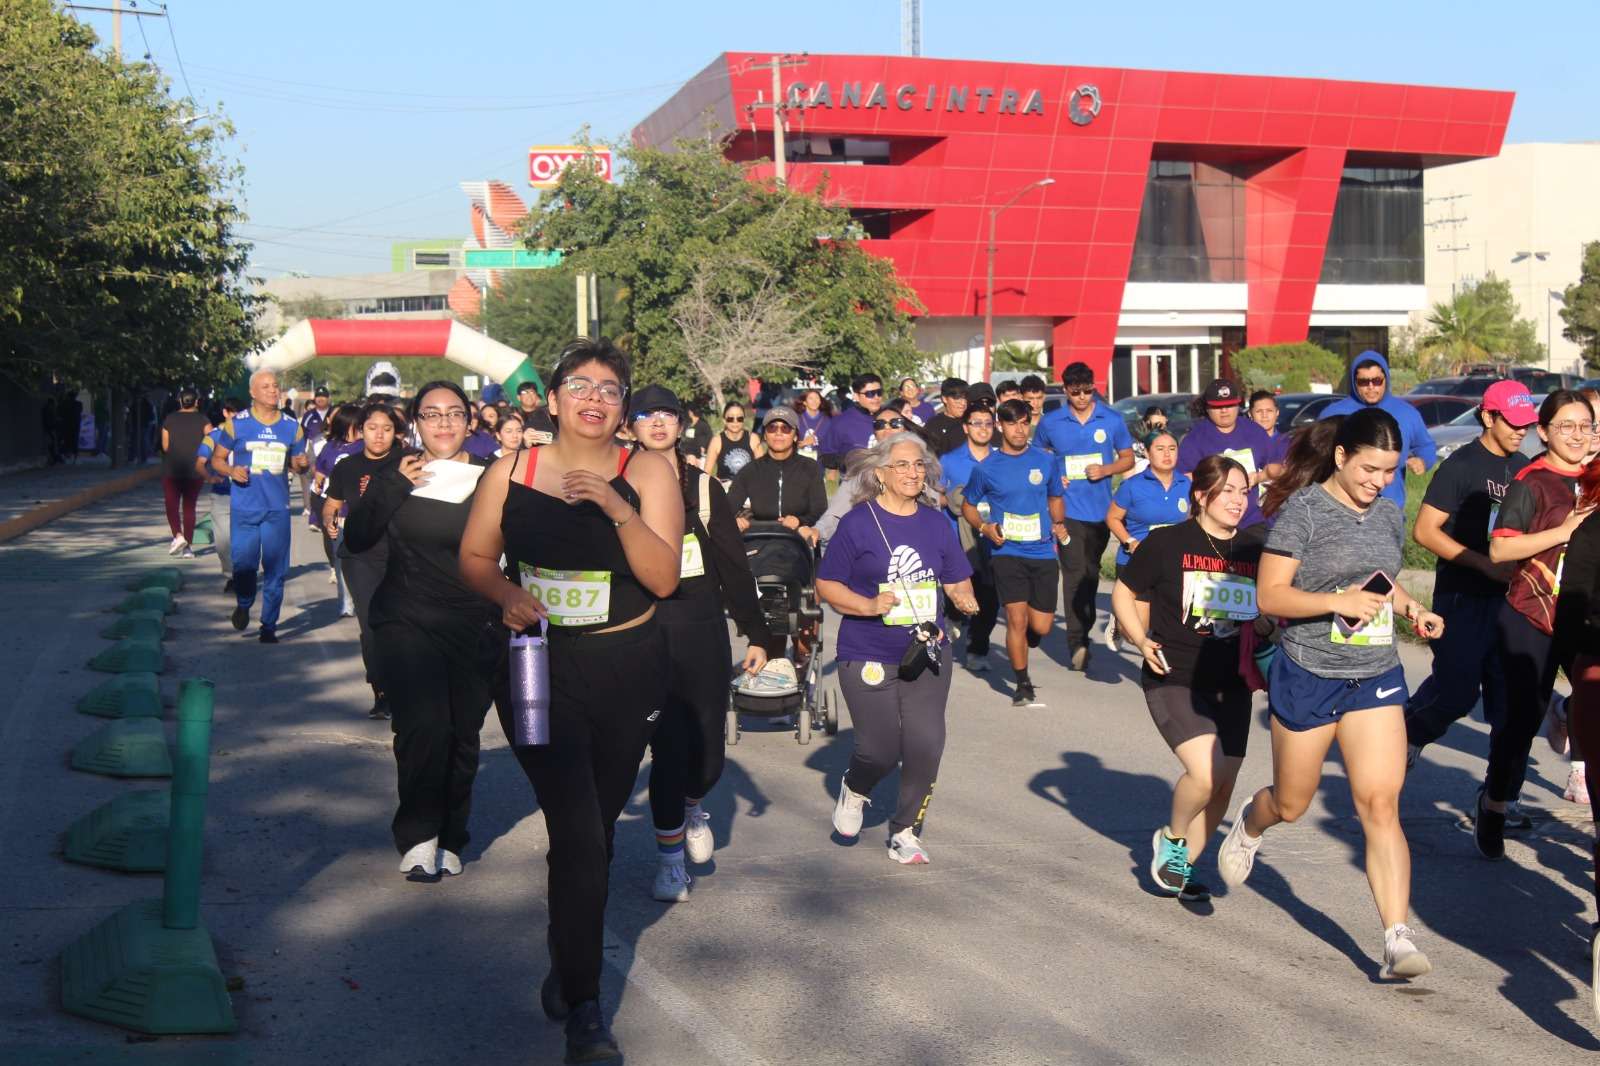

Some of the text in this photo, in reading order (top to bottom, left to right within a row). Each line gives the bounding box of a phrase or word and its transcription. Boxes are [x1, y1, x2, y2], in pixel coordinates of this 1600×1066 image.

[786, 81, 1045, 115] CANACINTRA
[532, 154, 608, 181] OXO
[1194, 555, 1224, 572] PACINO
[528, 583, 600, 608] 0687
